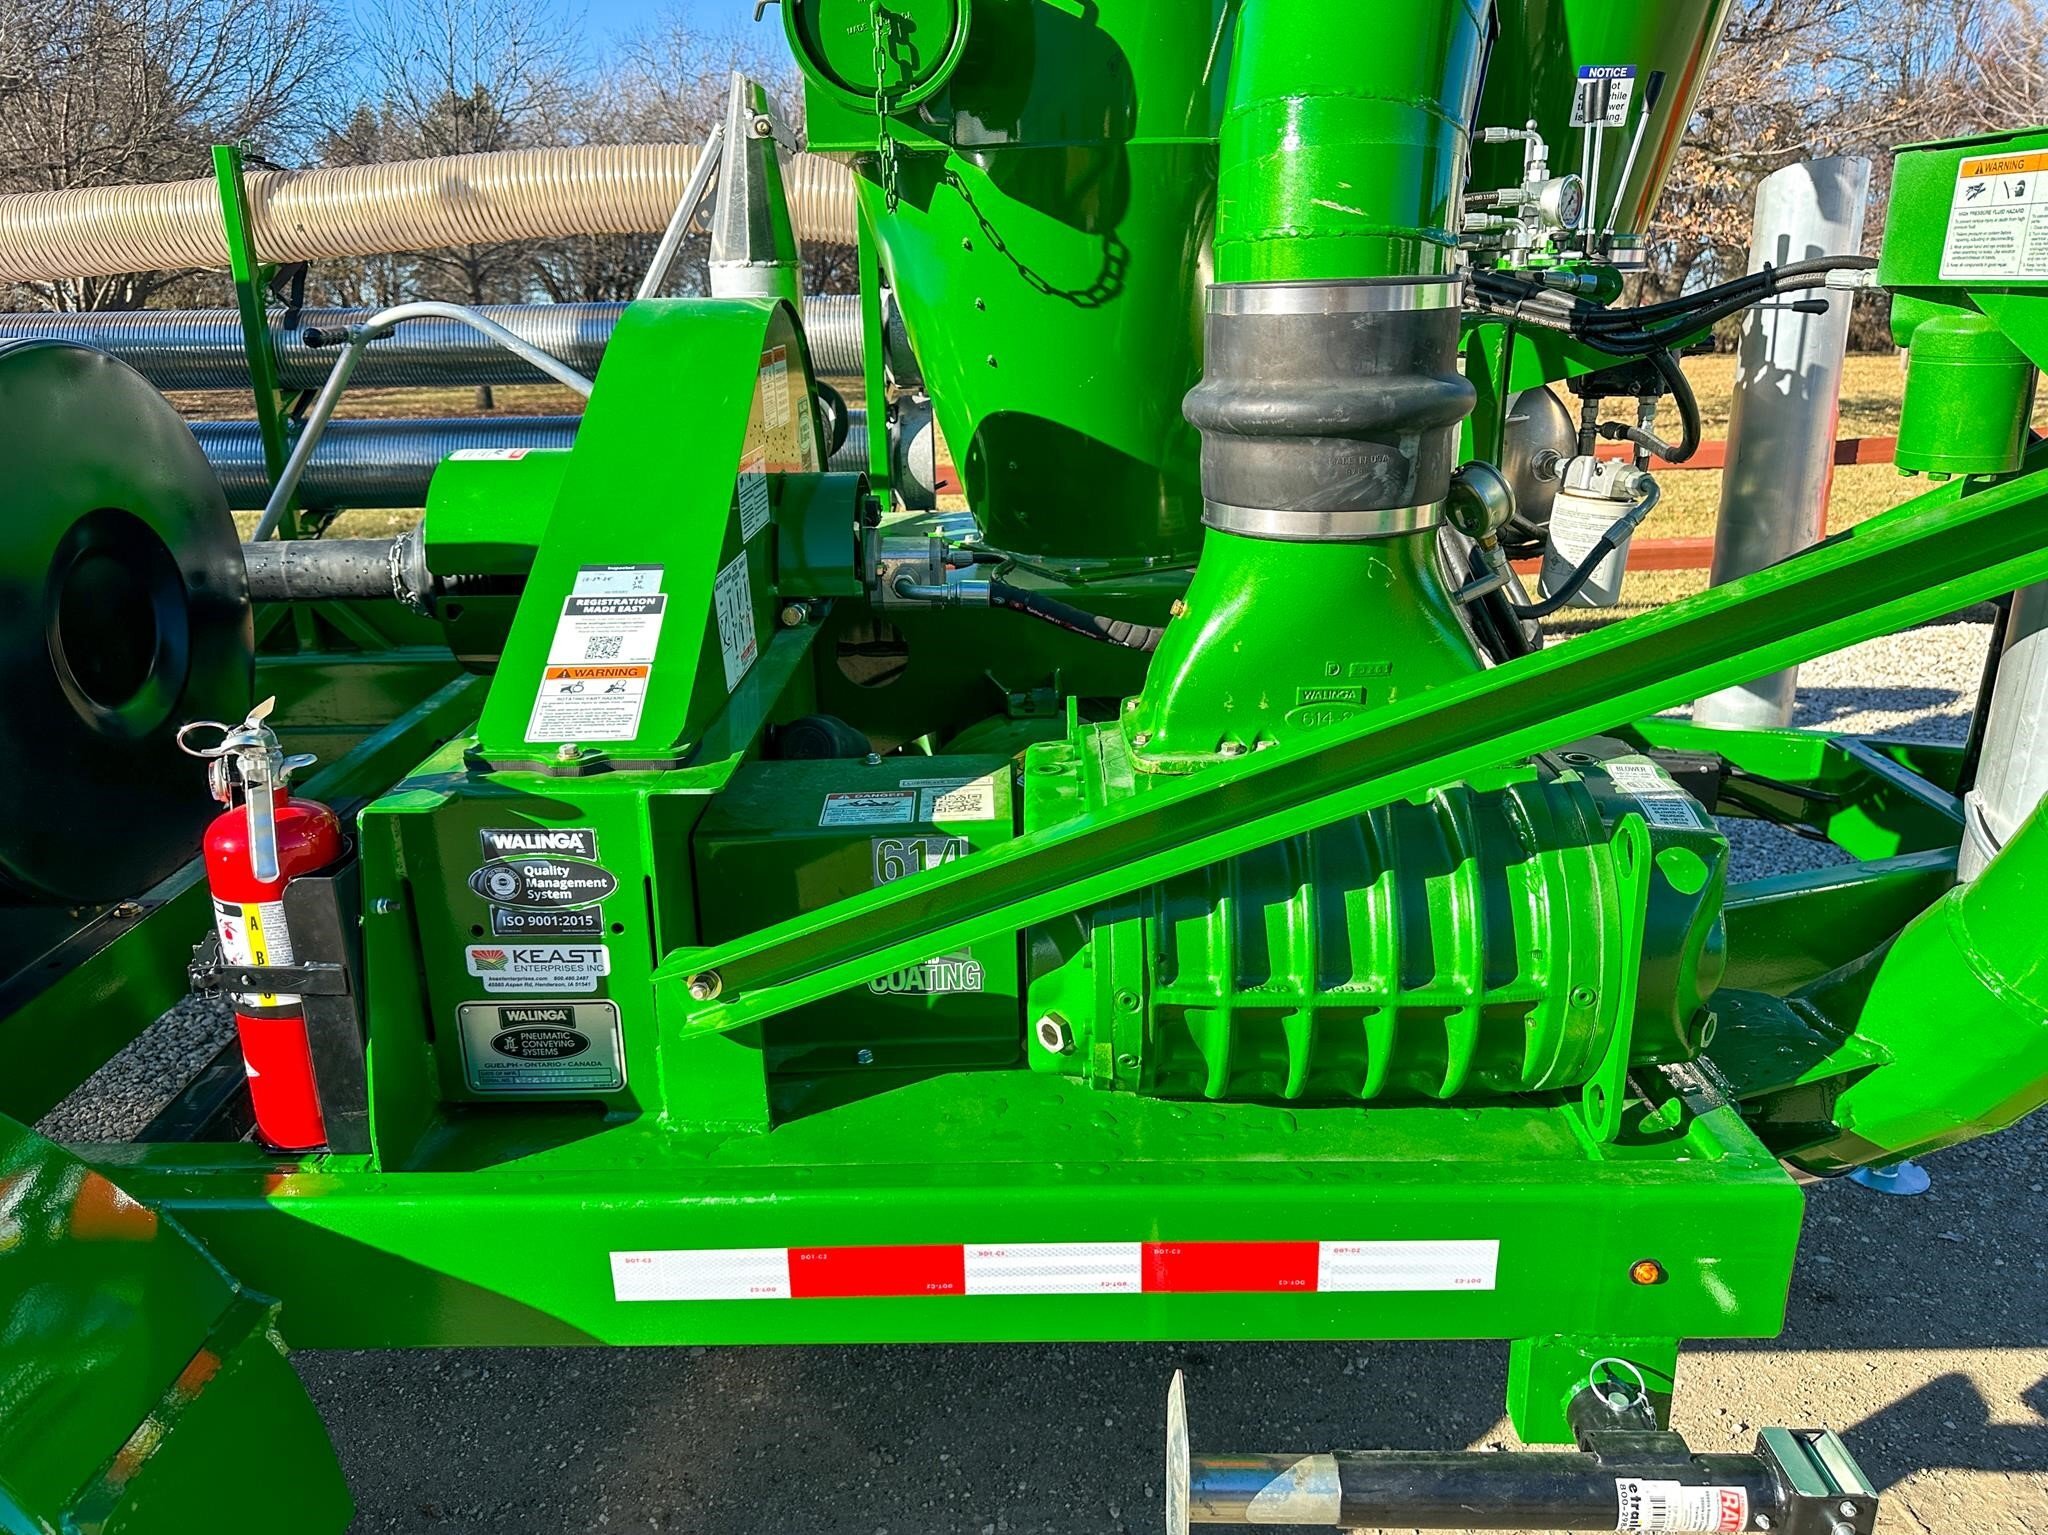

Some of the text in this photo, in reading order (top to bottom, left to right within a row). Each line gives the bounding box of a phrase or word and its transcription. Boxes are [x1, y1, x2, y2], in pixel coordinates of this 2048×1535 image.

[1589, 67, 1627, 77] NOTICE
[1985, 160, 2025, 173] WARNING
[576, 598, 656, 606] REGISTRATION
[574, 668, 638, 678] WARNING
[1304, 690, 1356, 700] WALINGA
[493, 833, 585, 850] WALINGA
[877, 839, 962, 886] 614
[524, 866, 570, 877] Quality
[526, 878, 608, 890] Management
[527, 889, 572, 901] System
[251, 916, 259, 931] A
[502, 915, 593, 926] ISO 9001:2015
[256, 951, 265, 966] B
[513, 950, 603, 963] KEAST
[514, 964, 605, 973] ENTERPRISES INC
[506, 1010, 567, 1021] WALINGA
[520, 1032, 570, 1040] PNEUMATIC
[521, 1040, 576, 1048] CONVEYING
[522, 1048, 559, 1056] SYSTEMS
